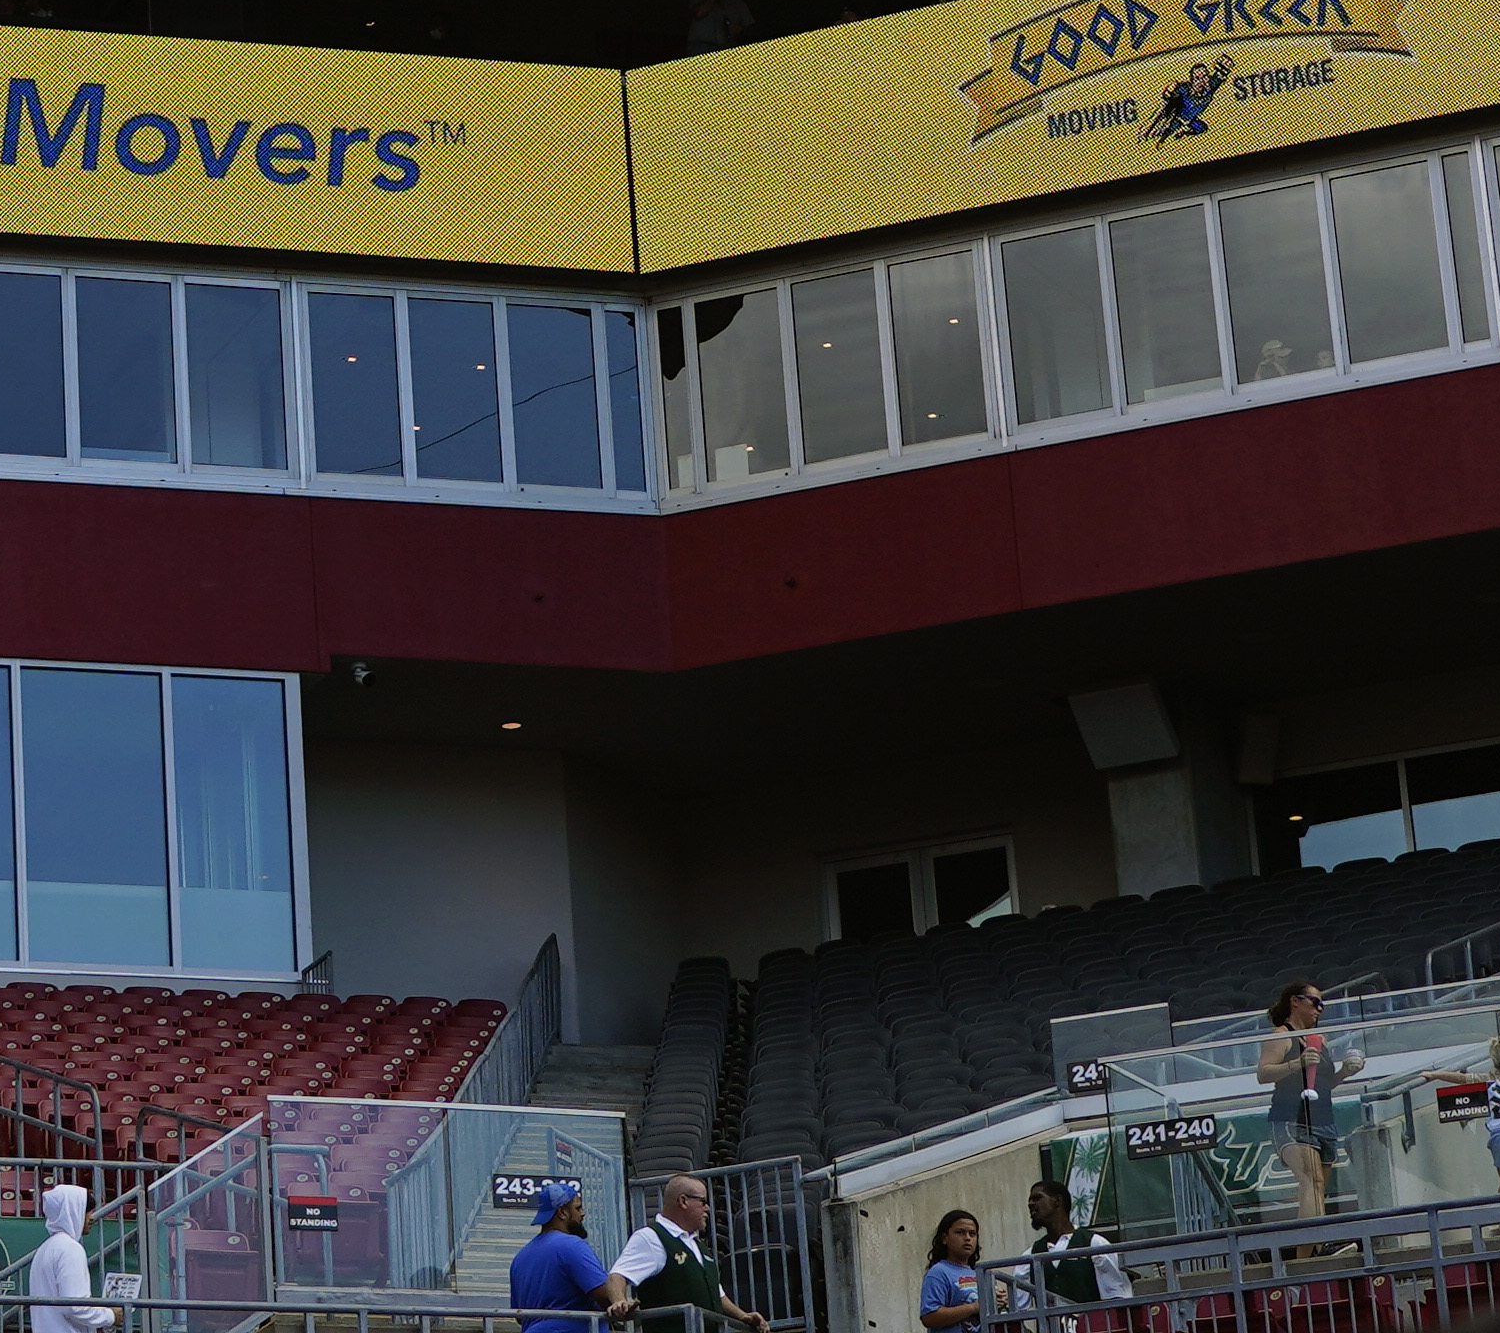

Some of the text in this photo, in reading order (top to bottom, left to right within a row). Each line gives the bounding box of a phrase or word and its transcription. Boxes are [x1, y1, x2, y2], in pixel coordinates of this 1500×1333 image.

[1046, 58, 1336, 138] MOVING STORAGE
[1456, 1097, 1470, 1105] NO
[1440, 1106, 1489, 1119] STANDING
[1128, 1118, 1215, 1146] 241-240
[306, 1208, 321, 1216] NO
[290, 1218, 338, 1228] STANDING
